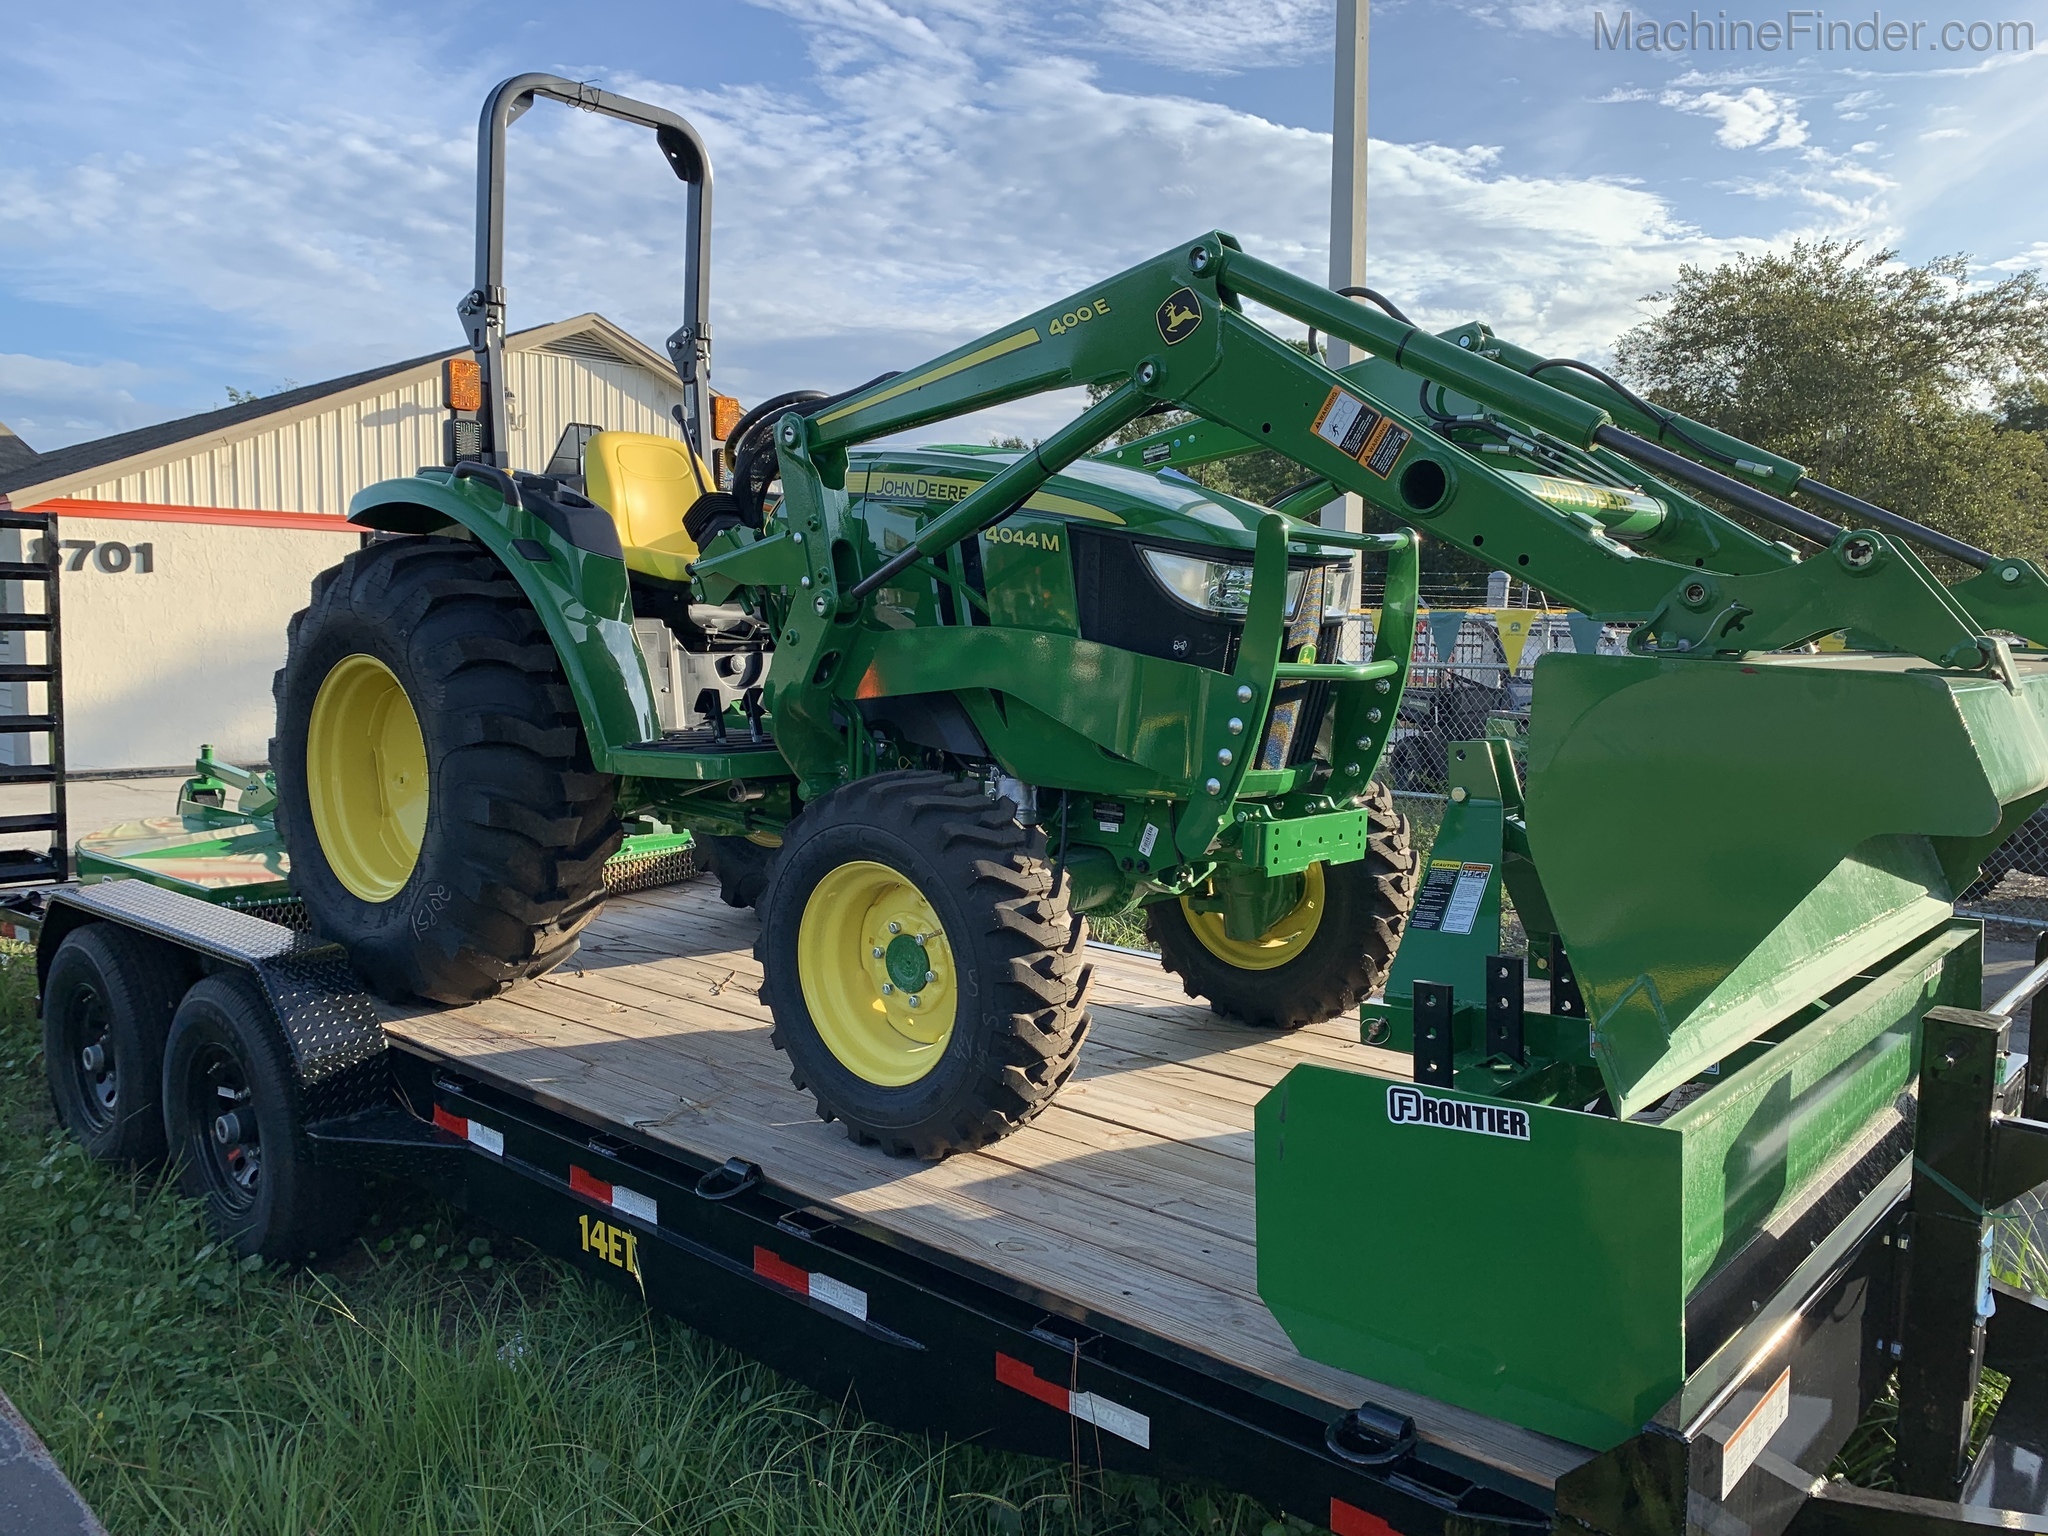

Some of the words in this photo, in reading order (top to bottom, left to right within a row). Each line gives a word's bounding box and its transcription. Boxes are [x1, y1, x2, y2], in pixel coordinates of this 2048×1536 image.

[1049, 306, 1093, 336] 400
[1092, 297, 1111, 316] E
[1319, 391, 1338, 421] WARNING
[1369, 423, 1388, 453] WARNING
[876, 477, 915, 496] JOHN
[916, 479, 969, 499] DEERE
[985, 525, 1039, 548] 4044
[1041, 532, 1060, 552] M
[1389, 1088, 1529, 1138] FRONTIER
[579, 1214, 638, 1273] 14ET
